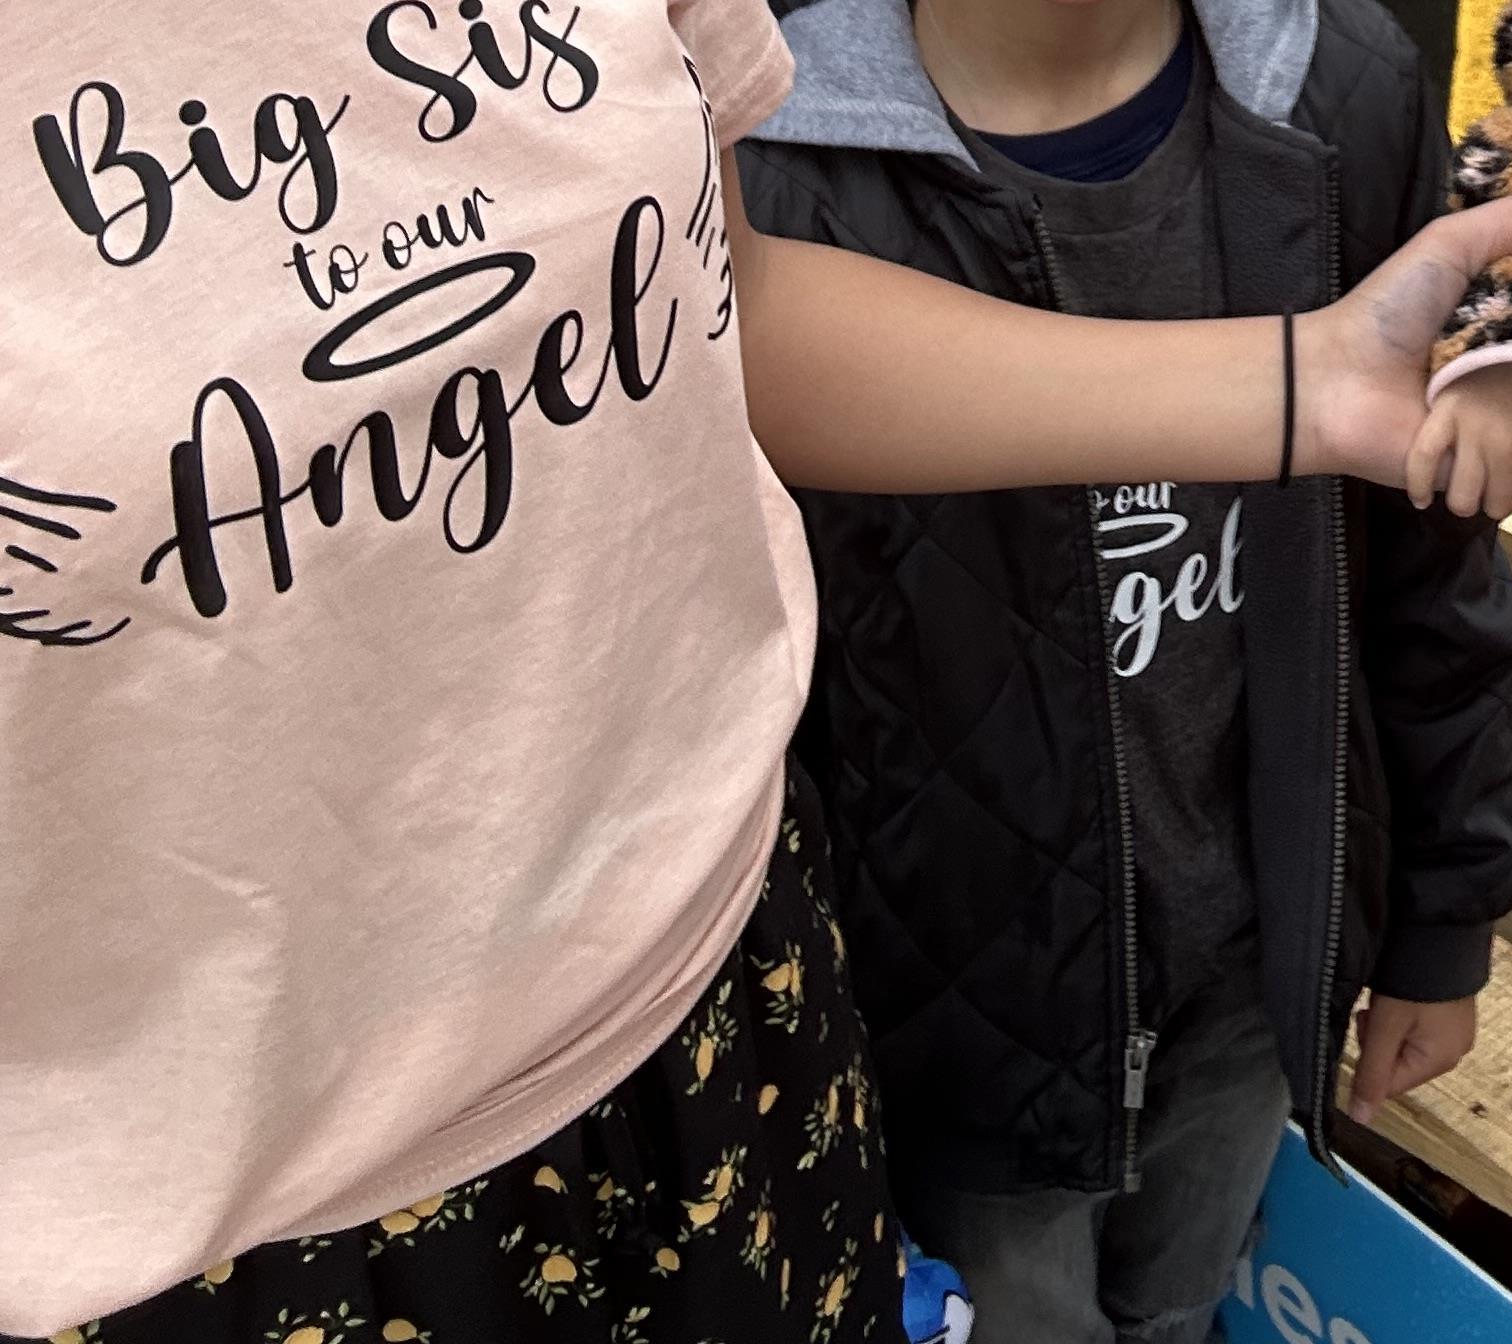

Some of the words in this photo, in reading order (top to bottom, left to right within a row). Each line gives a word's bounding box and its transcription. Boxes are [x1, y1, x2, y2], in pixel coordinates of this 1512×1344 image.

[32, 80, 351, 266] Big
[283, 241, 369, 310] to
[382, 186, 495, 271] our
[140, 195, 678, 618] Angel
[1110, 496, 1246, 677] gel
[1113, 481, 1177, 514] our
